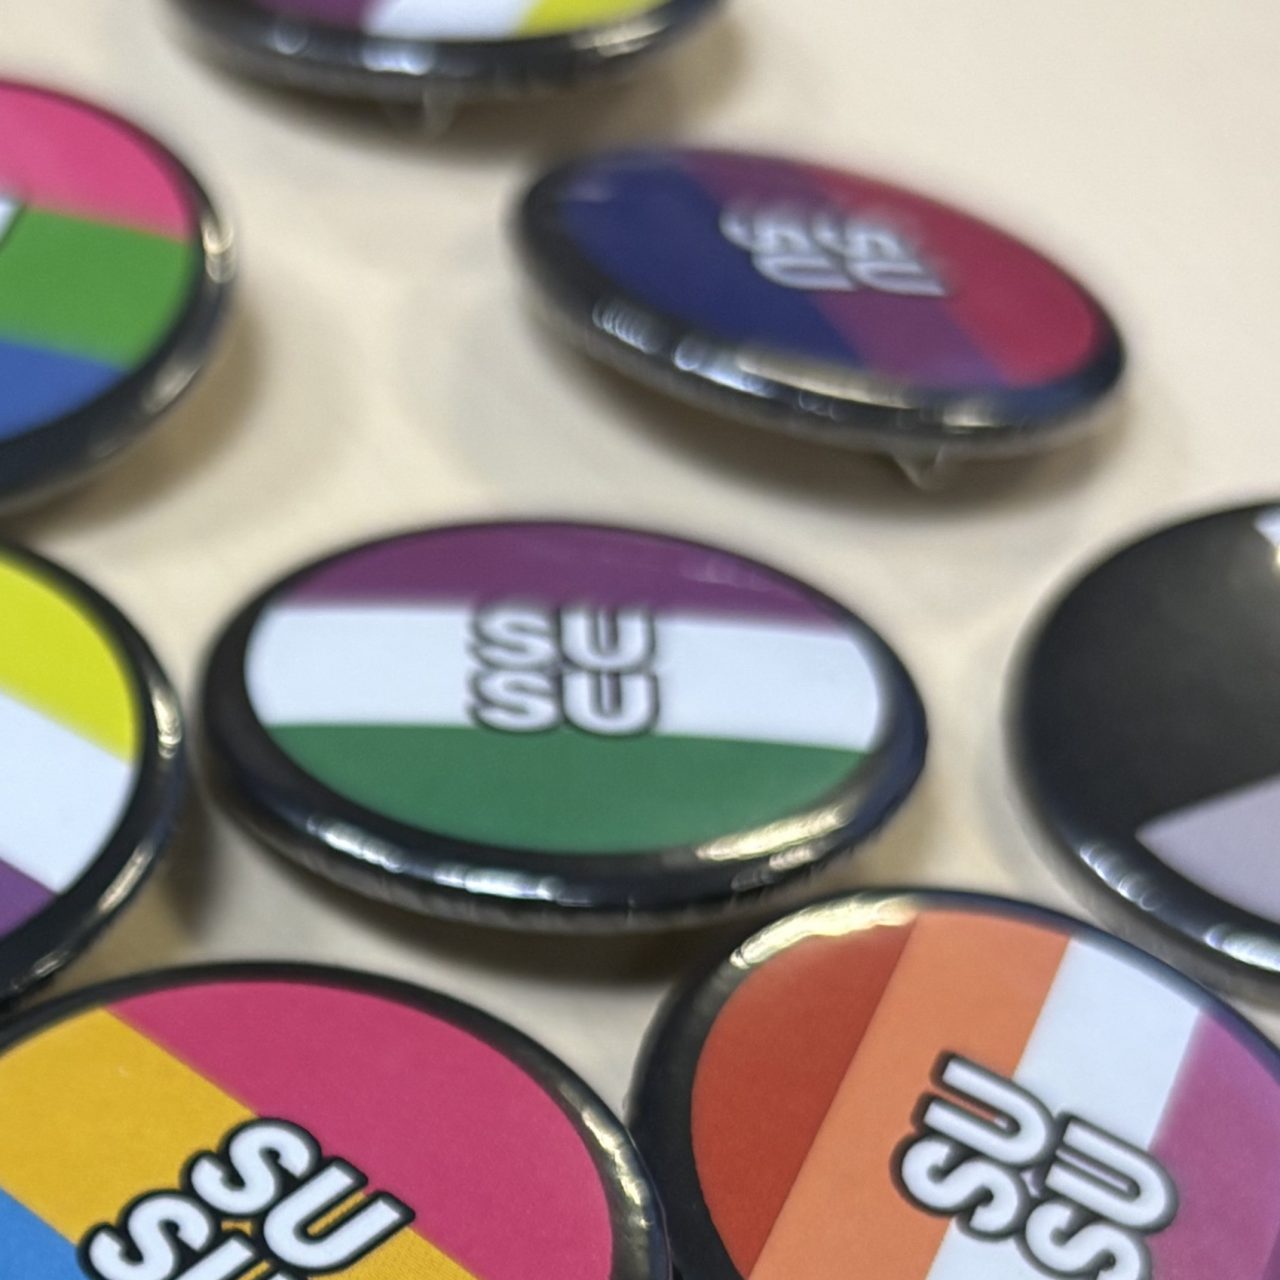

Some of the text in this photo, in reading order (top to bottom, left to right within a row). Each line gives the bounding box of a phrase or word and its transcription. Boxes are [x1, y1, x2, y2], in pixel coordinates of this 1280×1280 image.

[476, 606, 649, 673] SU
[476, 668, 656, 737] SU
[189, 1121, 404, 1272] SU
[899, 1056, 1050, 1235] SU
